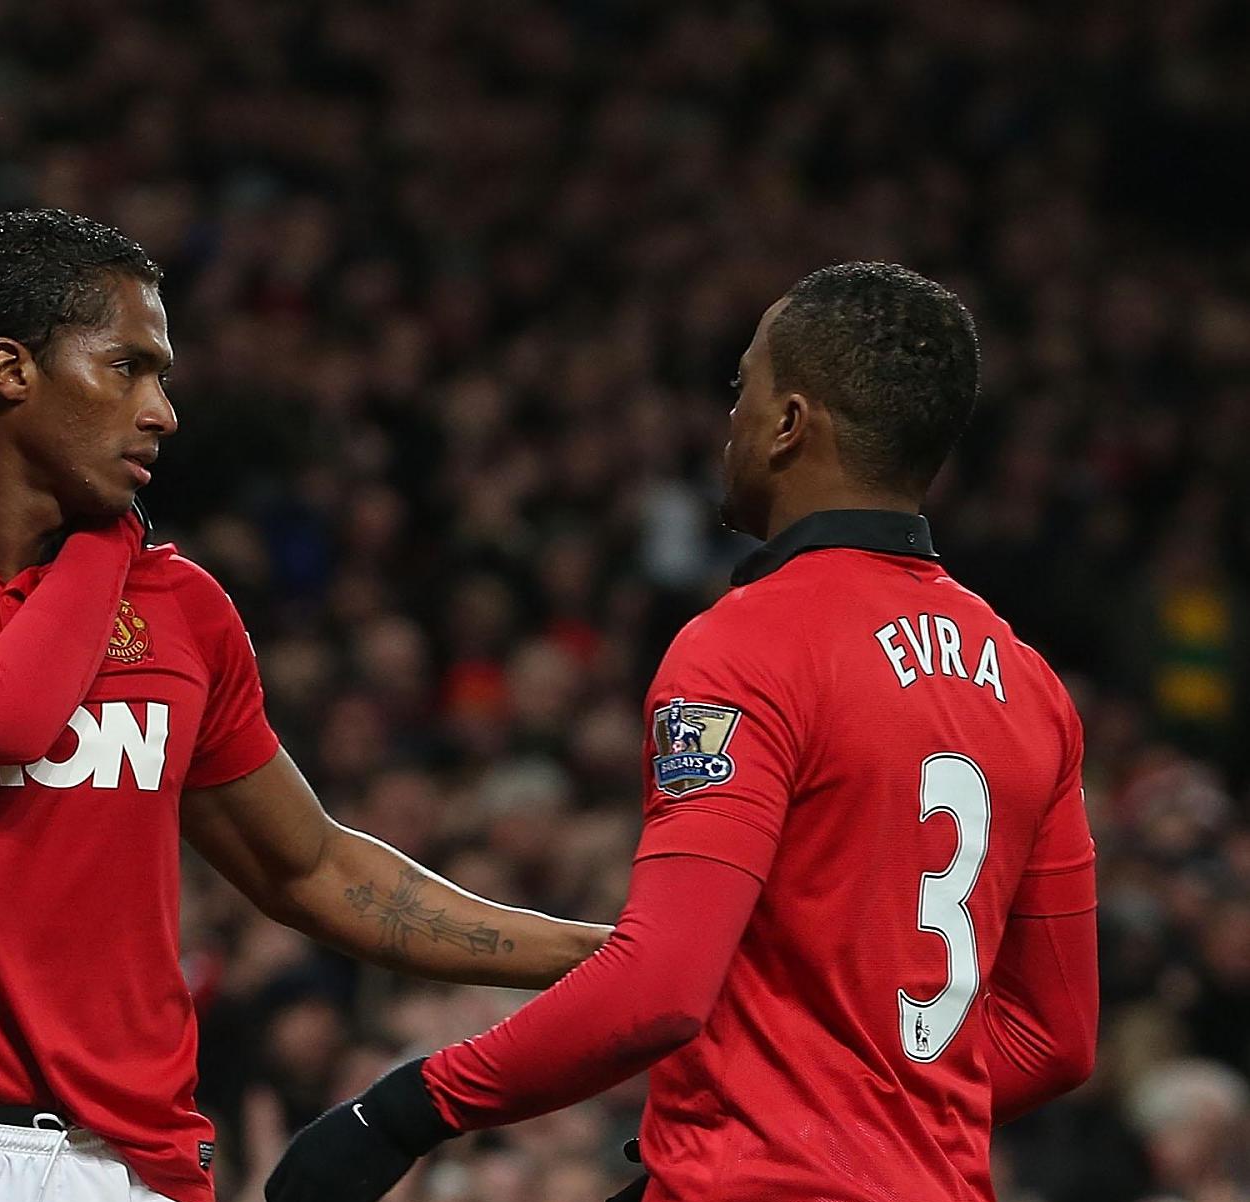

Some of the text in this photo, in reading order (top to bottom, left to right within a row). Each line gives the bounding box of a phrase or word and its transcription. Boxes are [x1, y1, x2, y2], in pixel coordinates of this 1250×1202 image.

[107, 640, 145, 657] UNITED
[874, 613, 1007, 704] EVRA
[897, 751, 993, 1064] 3
